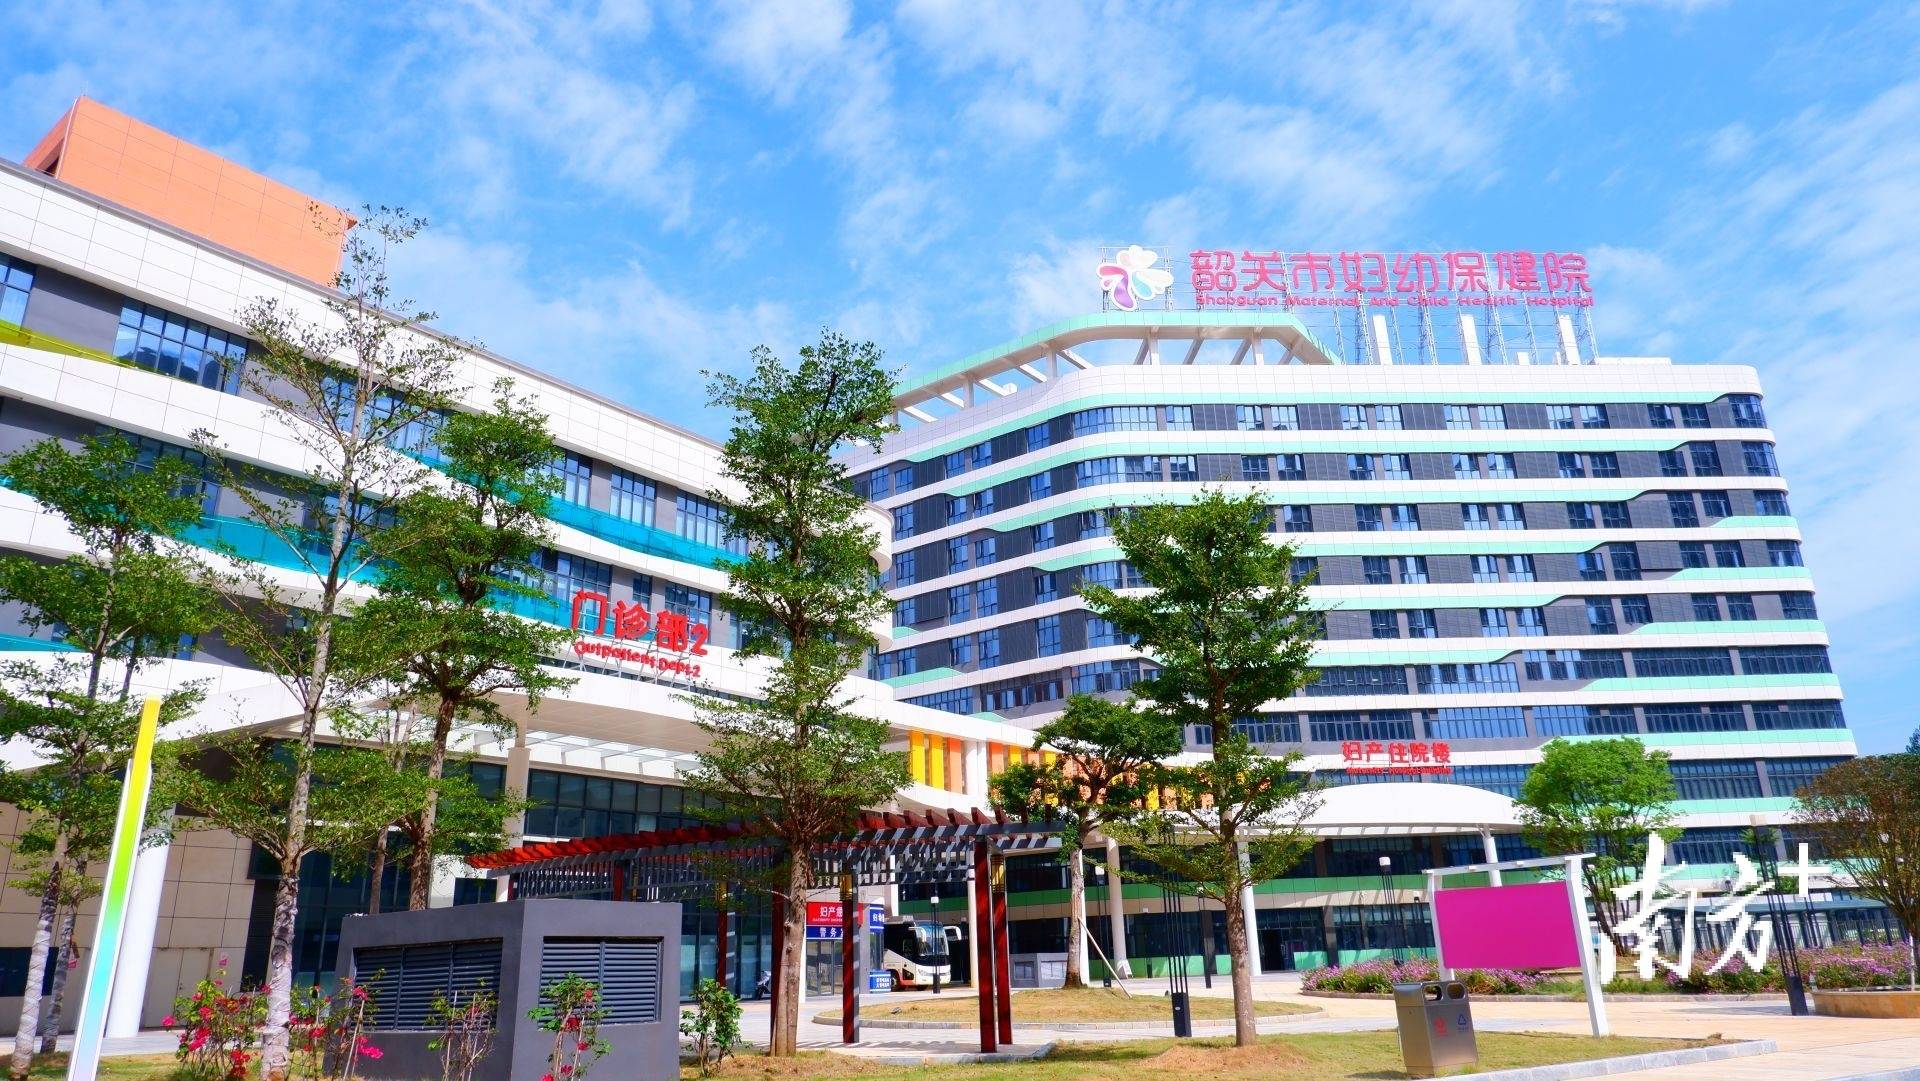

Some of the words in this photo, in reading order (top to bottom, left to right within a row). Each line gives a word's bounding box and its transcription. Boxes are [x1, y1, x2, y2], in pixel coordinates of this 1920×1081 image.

[1190, 250, 1593, 293] 韶关市妇幼保健院
[1407, 296, 1449, 306] Child
[1457, 296, 1518, 306] Health
[1526, 296, 1594, 307] Hospital
[571, 588, 709, 656] 门诊部2
[574, 640, 656, 668] Outpatient
[1342, 741, 1451, 763] 妇产住院楼
